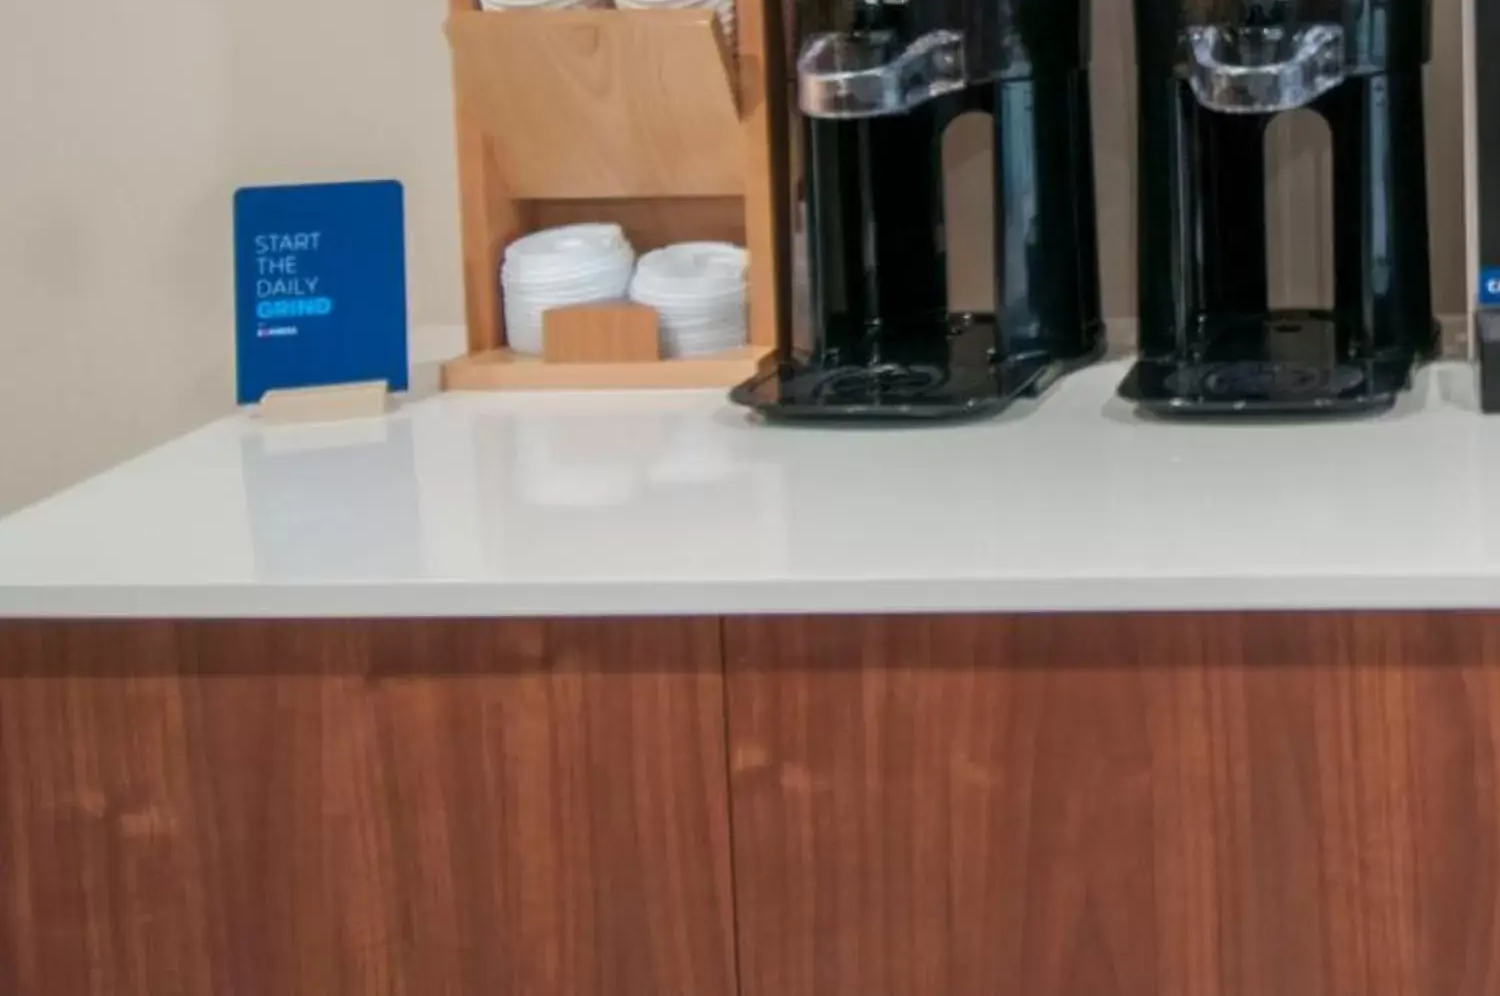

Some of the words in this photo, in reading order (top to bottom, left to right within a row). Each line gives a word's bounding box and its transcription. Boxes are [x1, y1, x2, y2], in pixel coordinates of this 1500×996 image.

[254, 231, 321, 255] START
[256, 255, 298, 275] THE
[256, 276, 319, 298] DAILY
[256, 297, 332, 318] GRIND
